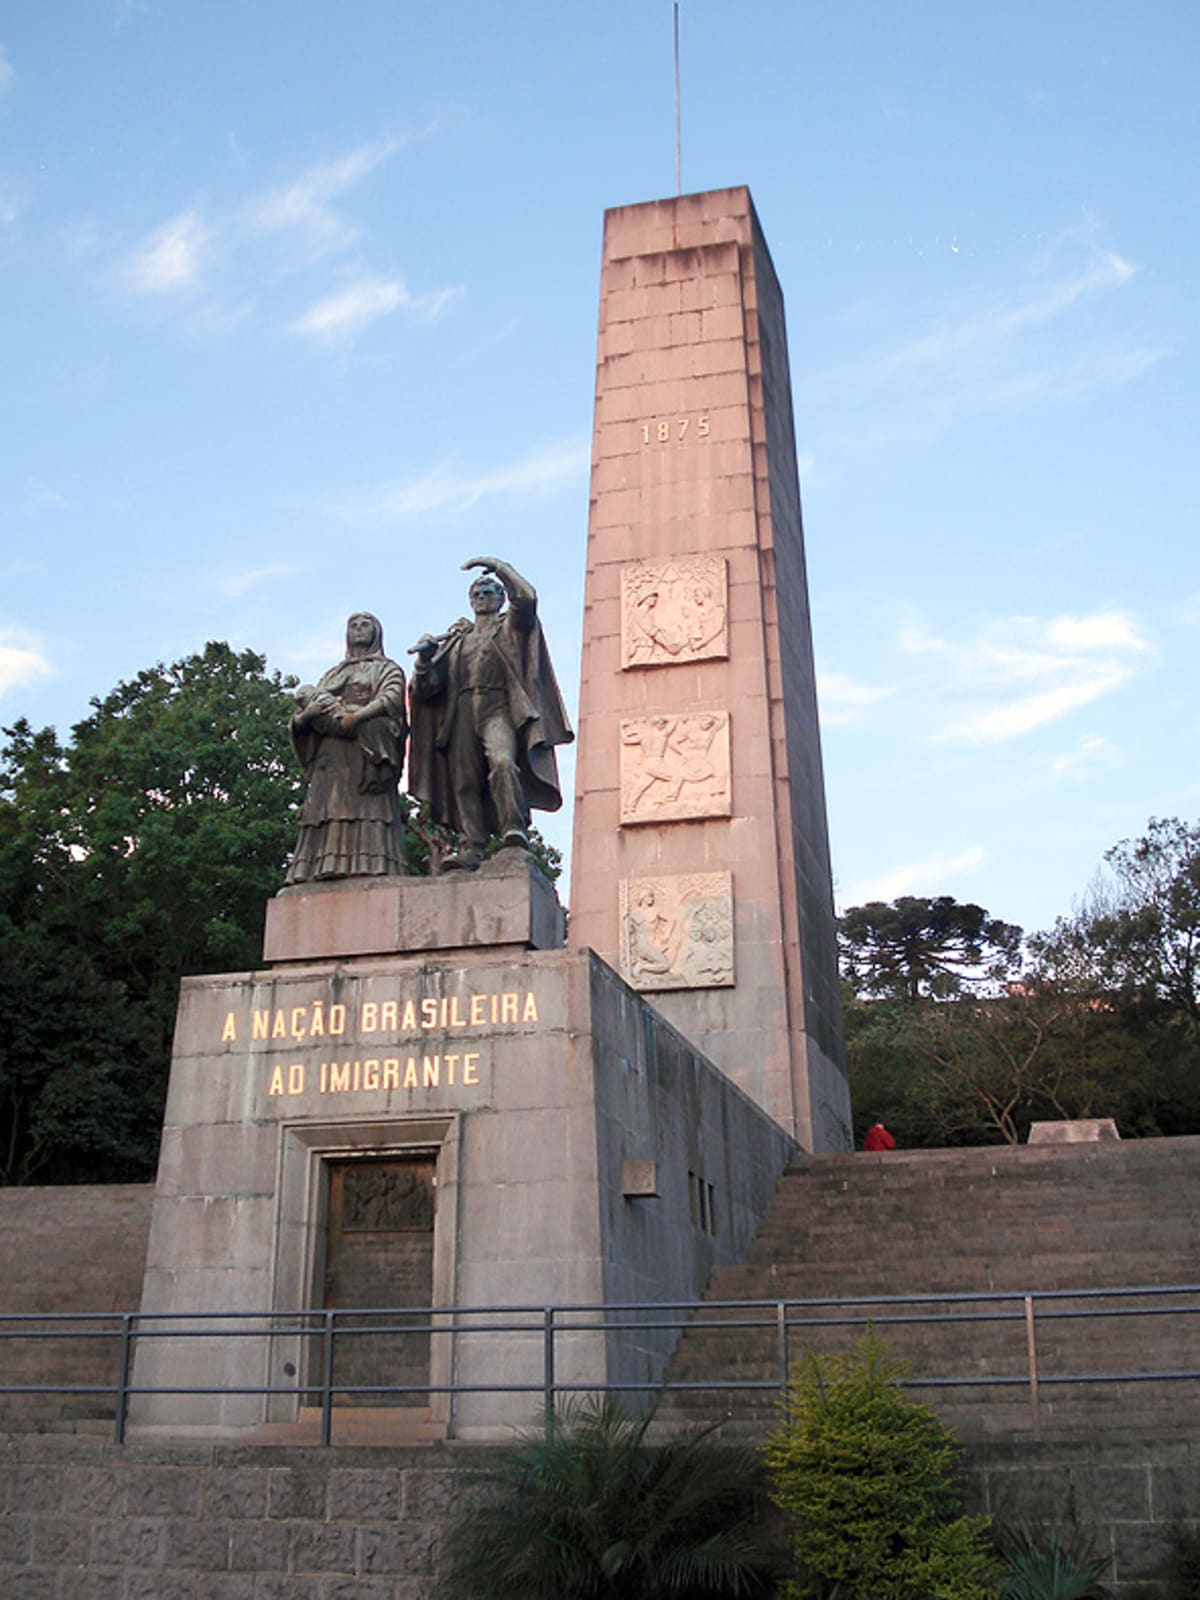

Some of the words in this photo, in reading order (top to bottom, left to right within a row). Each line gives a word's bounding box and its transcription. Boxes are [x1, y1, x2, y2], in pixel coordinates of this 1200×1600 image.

[641, 416, 709, 443] 1875
[221, 1012, 236, 1042] A
[252, 1001, 346, 1043] NAÇÃO
[361, 992, 539, 1034] BRASILEIRA
[268, 1064, 304, 1096] AO
[319, 1053, 481, 1093] IMIGRANTE
